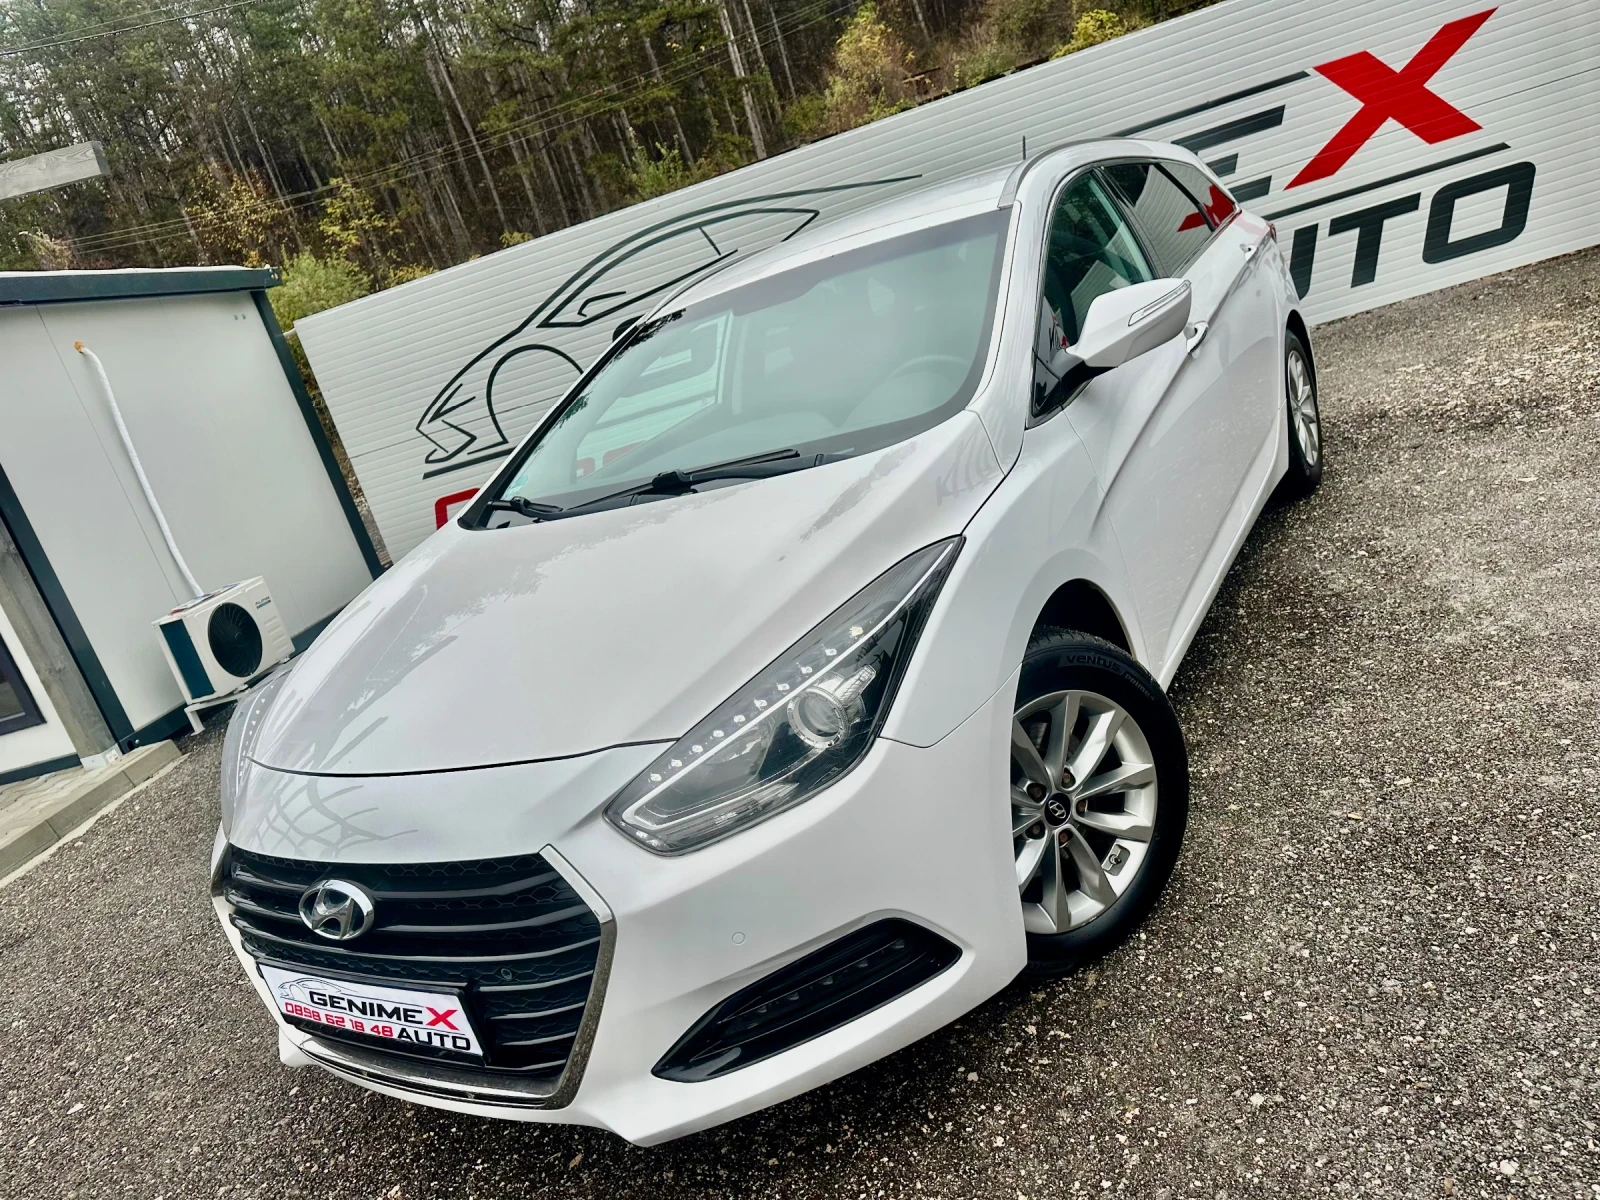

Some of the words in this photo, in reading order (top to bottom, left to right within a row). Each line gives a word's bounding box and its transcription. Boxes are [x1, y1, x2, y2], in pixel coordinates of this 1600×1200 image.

[285, 1002, 321, 1021] 0898
[325, 1015, 346, 1027] 62
[350, 1019, 365, 1032] 18
[370, 1024, 394, 1038] 48
[309, 990, 460, 1031] GENIMEX
[397, 1028, 471, 1051] AUTO
